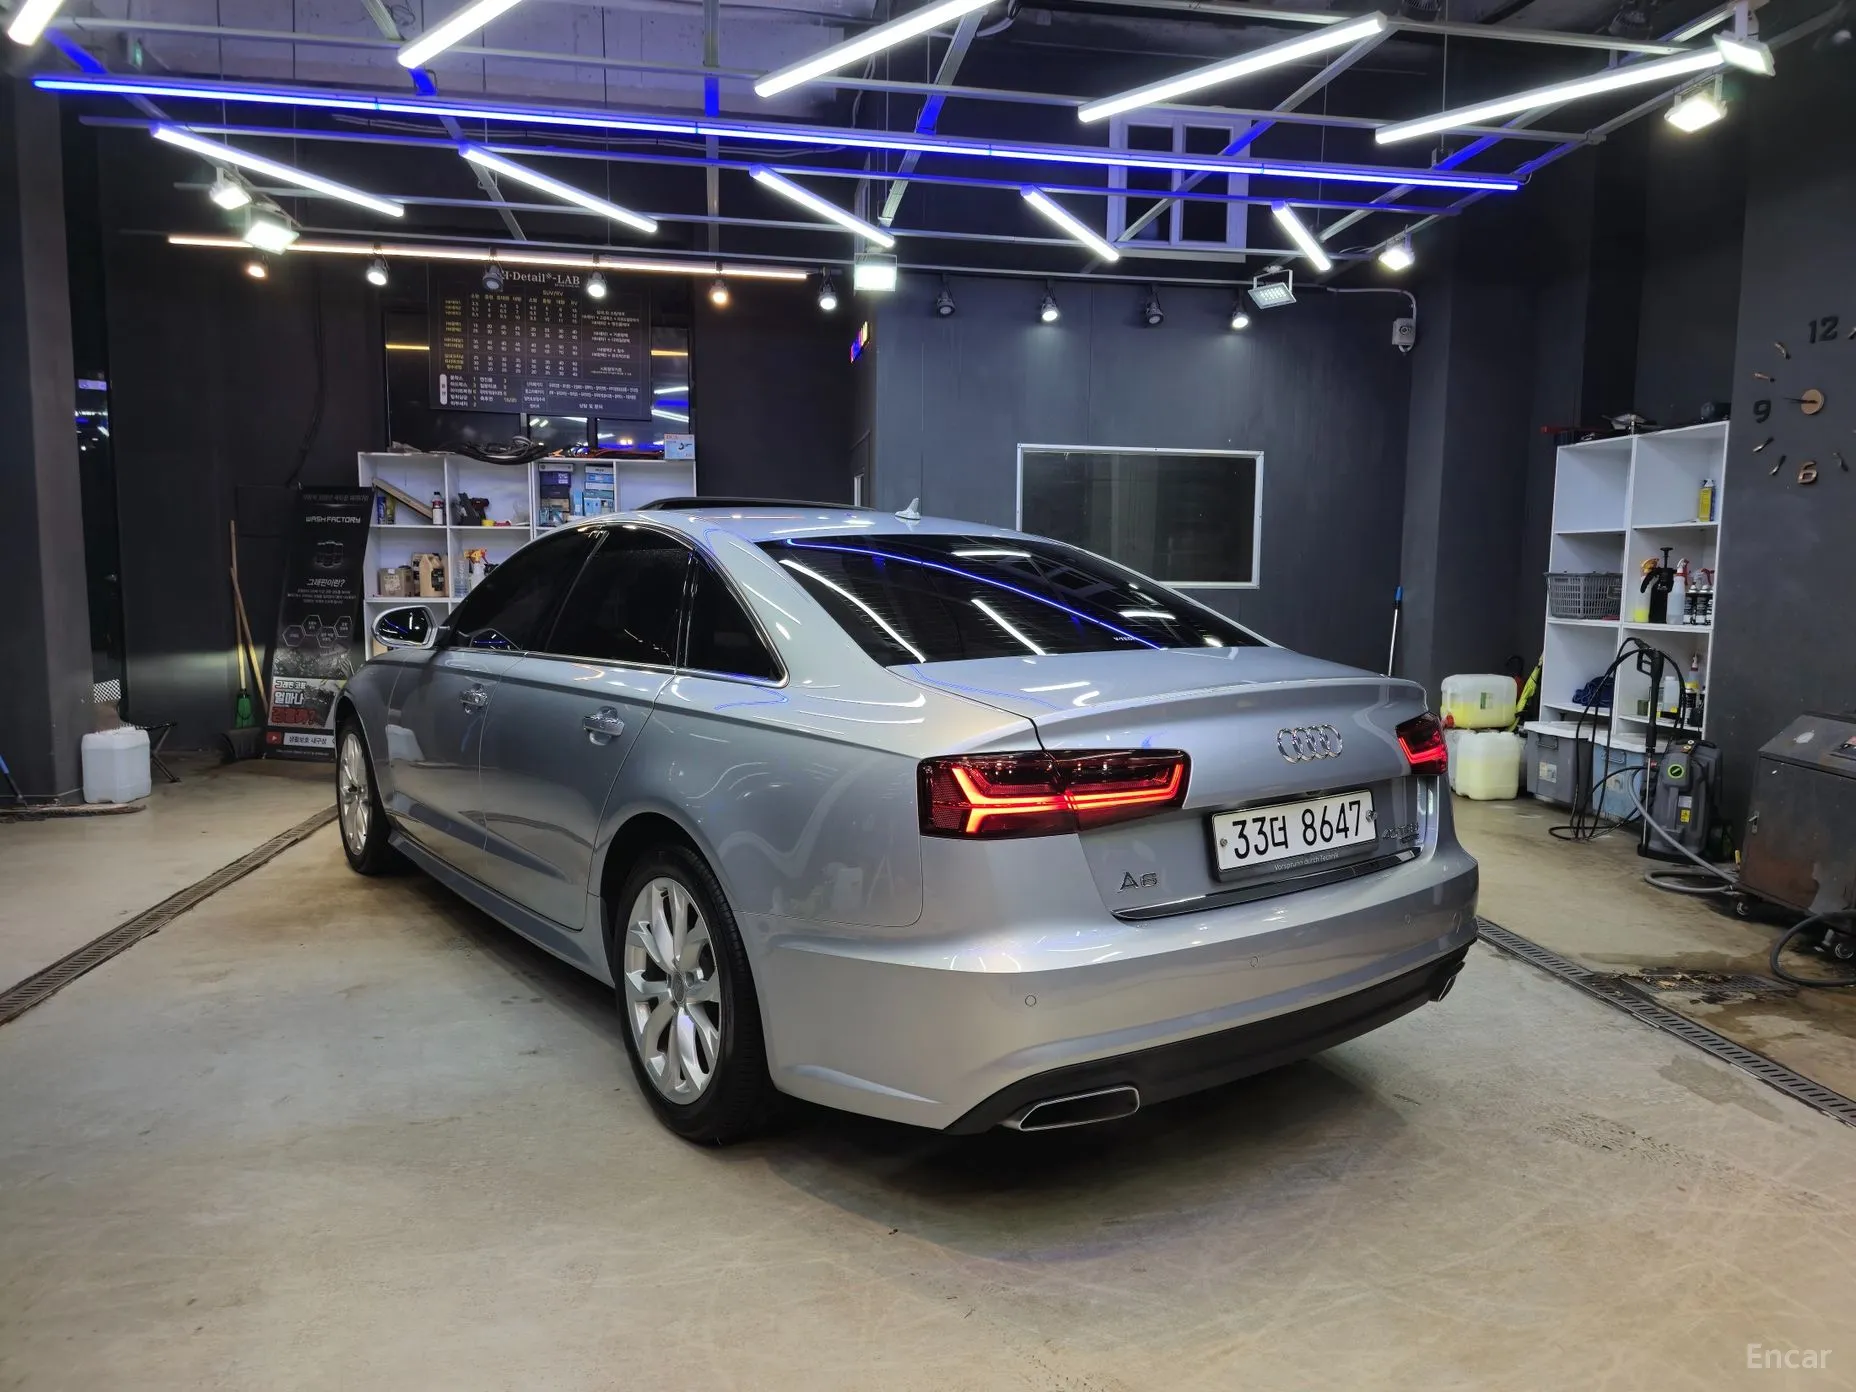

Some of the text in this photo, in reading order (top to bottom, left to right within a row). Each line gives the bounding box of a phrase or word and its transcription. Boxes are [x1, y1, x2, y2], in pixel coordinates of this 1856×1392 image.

[1808, 315, 1840, 344] 12
[1753, 399, 1772, 424] 9
[1797, 461, 1818, 485] 6
[274, 691, 304, 705] 얼마나
[1232, 800, 1360, 859] 33더 8647
[1117, 871, 1158, 893] A6
